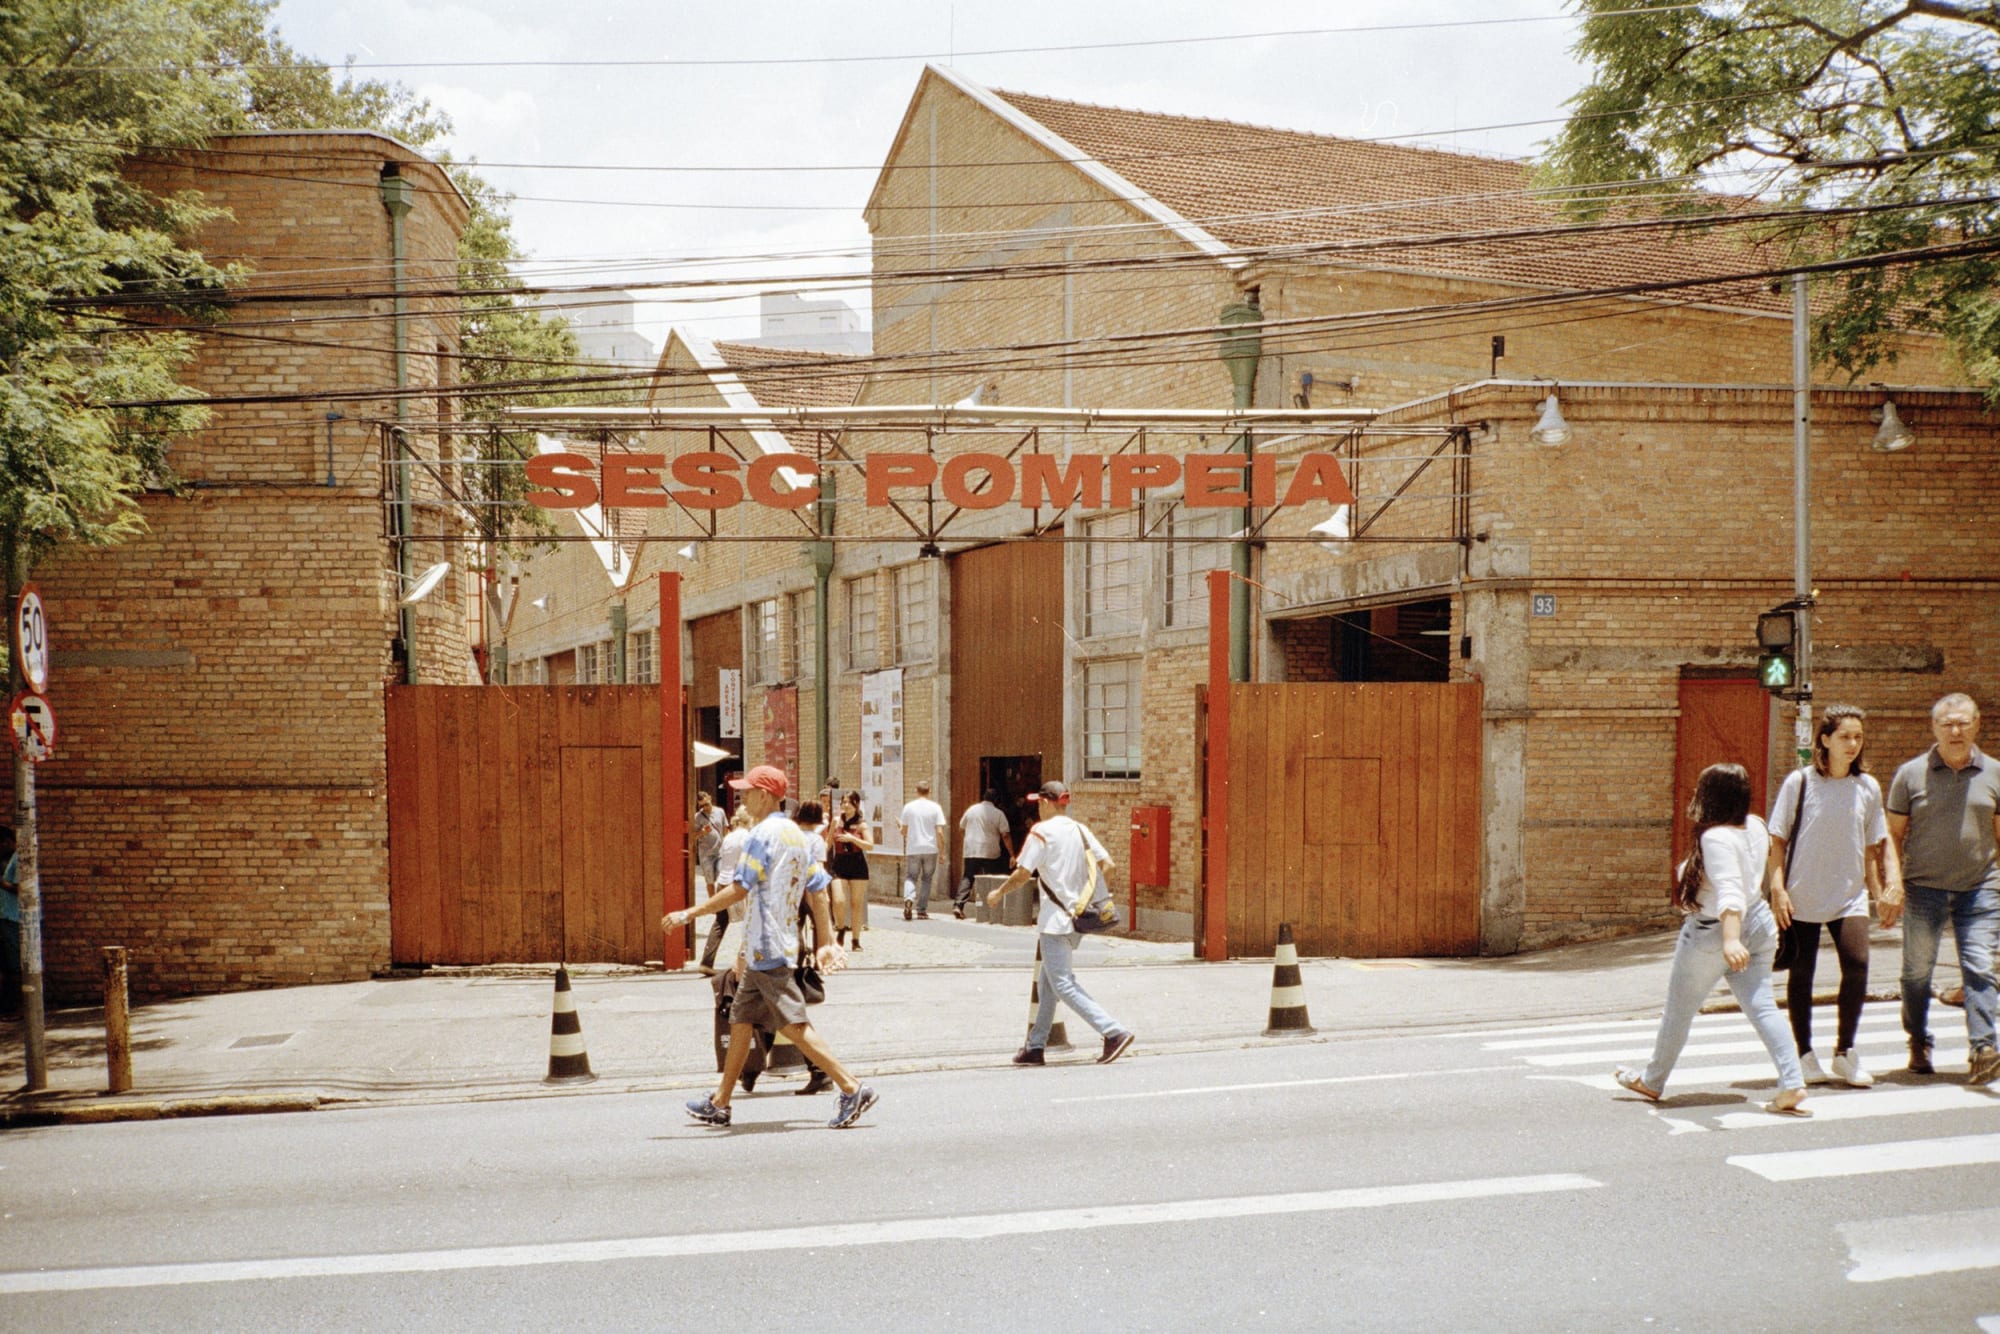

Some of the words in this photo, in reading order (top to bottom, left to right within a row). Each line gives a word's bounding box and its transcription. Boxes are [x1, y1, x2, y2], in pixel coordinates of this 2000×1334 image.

[525, 452, 821, 509] SESC
[865, 451, 1356, 509] POMPEIA
[22, 606, 42, 654] 50
[1536, 598, 1553, 614] 93
